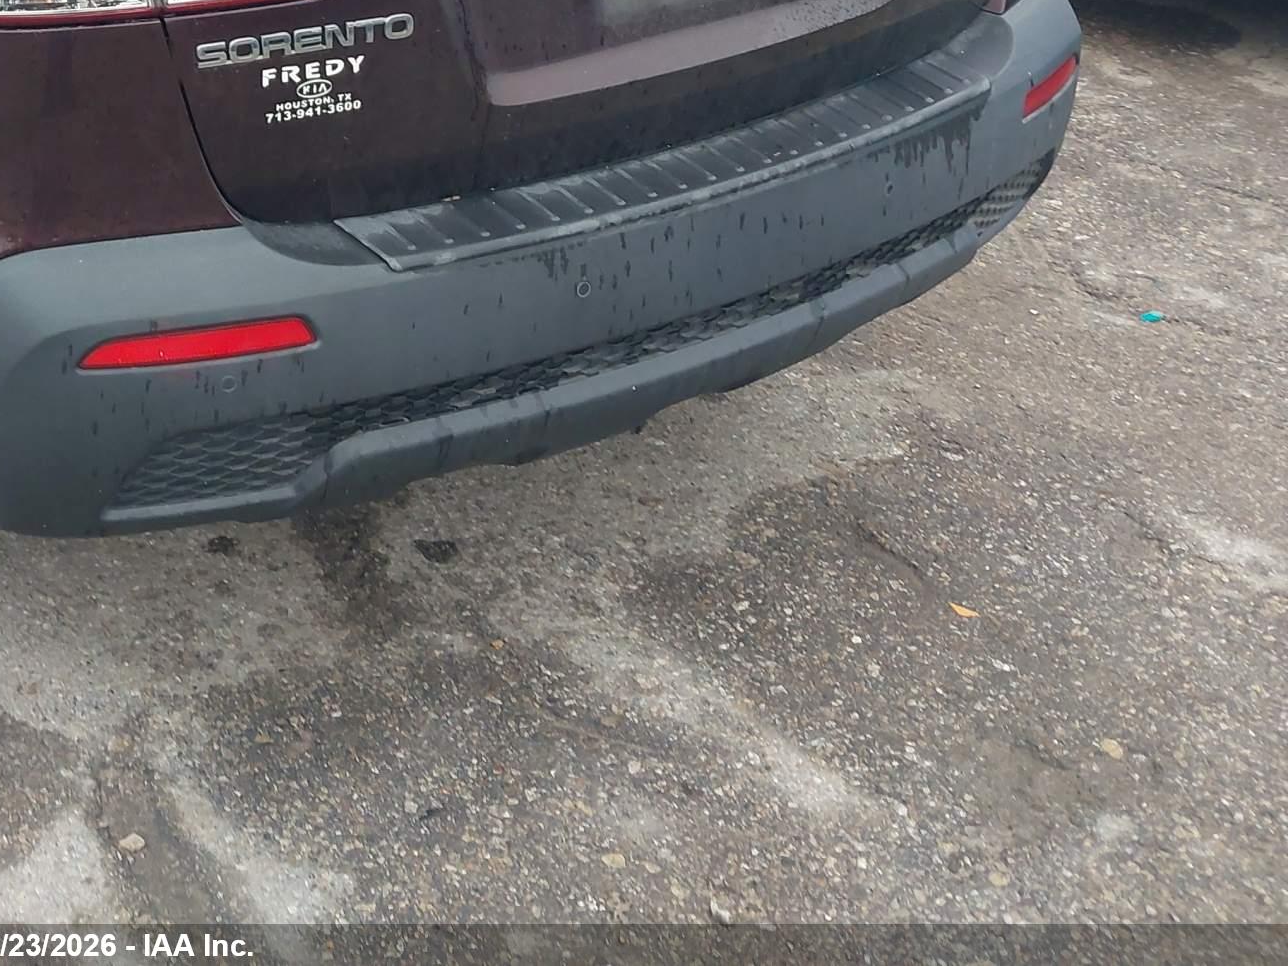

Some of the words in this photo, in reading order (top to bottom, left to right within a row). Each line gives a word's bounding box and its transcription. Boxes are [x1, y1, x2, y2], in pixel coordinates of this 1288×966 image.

[196, 12, 415, 69] SORENTO
[261, 55, 365, 88] FREDY
[302, 83, 327, 95] KIA
[265, 100, 362, 124] 713-941-3600
[275, 97, 334, 112] HOUSTON,
[337, 92, 352, 102] TX
